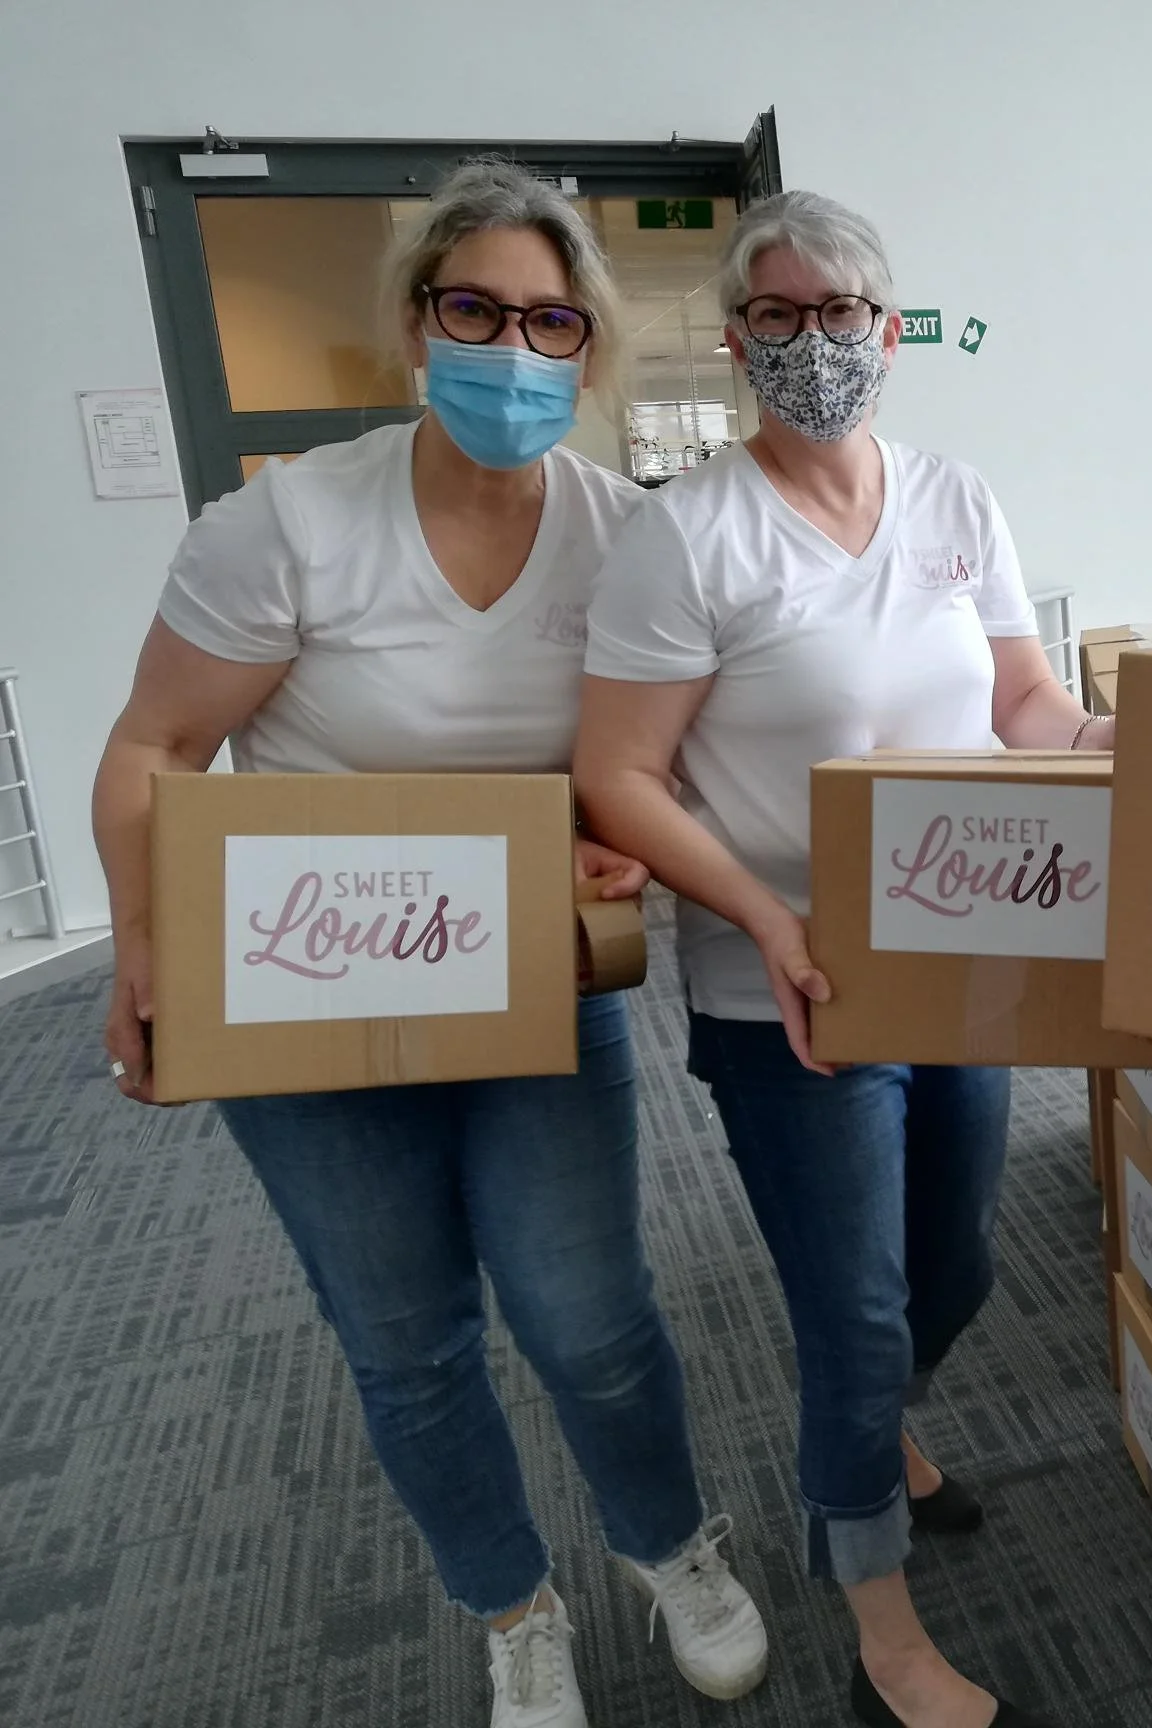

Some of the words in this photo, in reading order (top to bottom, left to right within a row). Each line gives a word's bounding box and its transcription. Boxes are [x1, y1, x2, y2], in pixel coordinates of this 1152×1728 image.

[902, 316, 938, 336] EXIT
[962, 816, 1049, 845] SWEET
[886, 814, 1101, 917] Louise
[333, 871, 433, 898] SWEET
[243, 871, 492, 980] Louise
